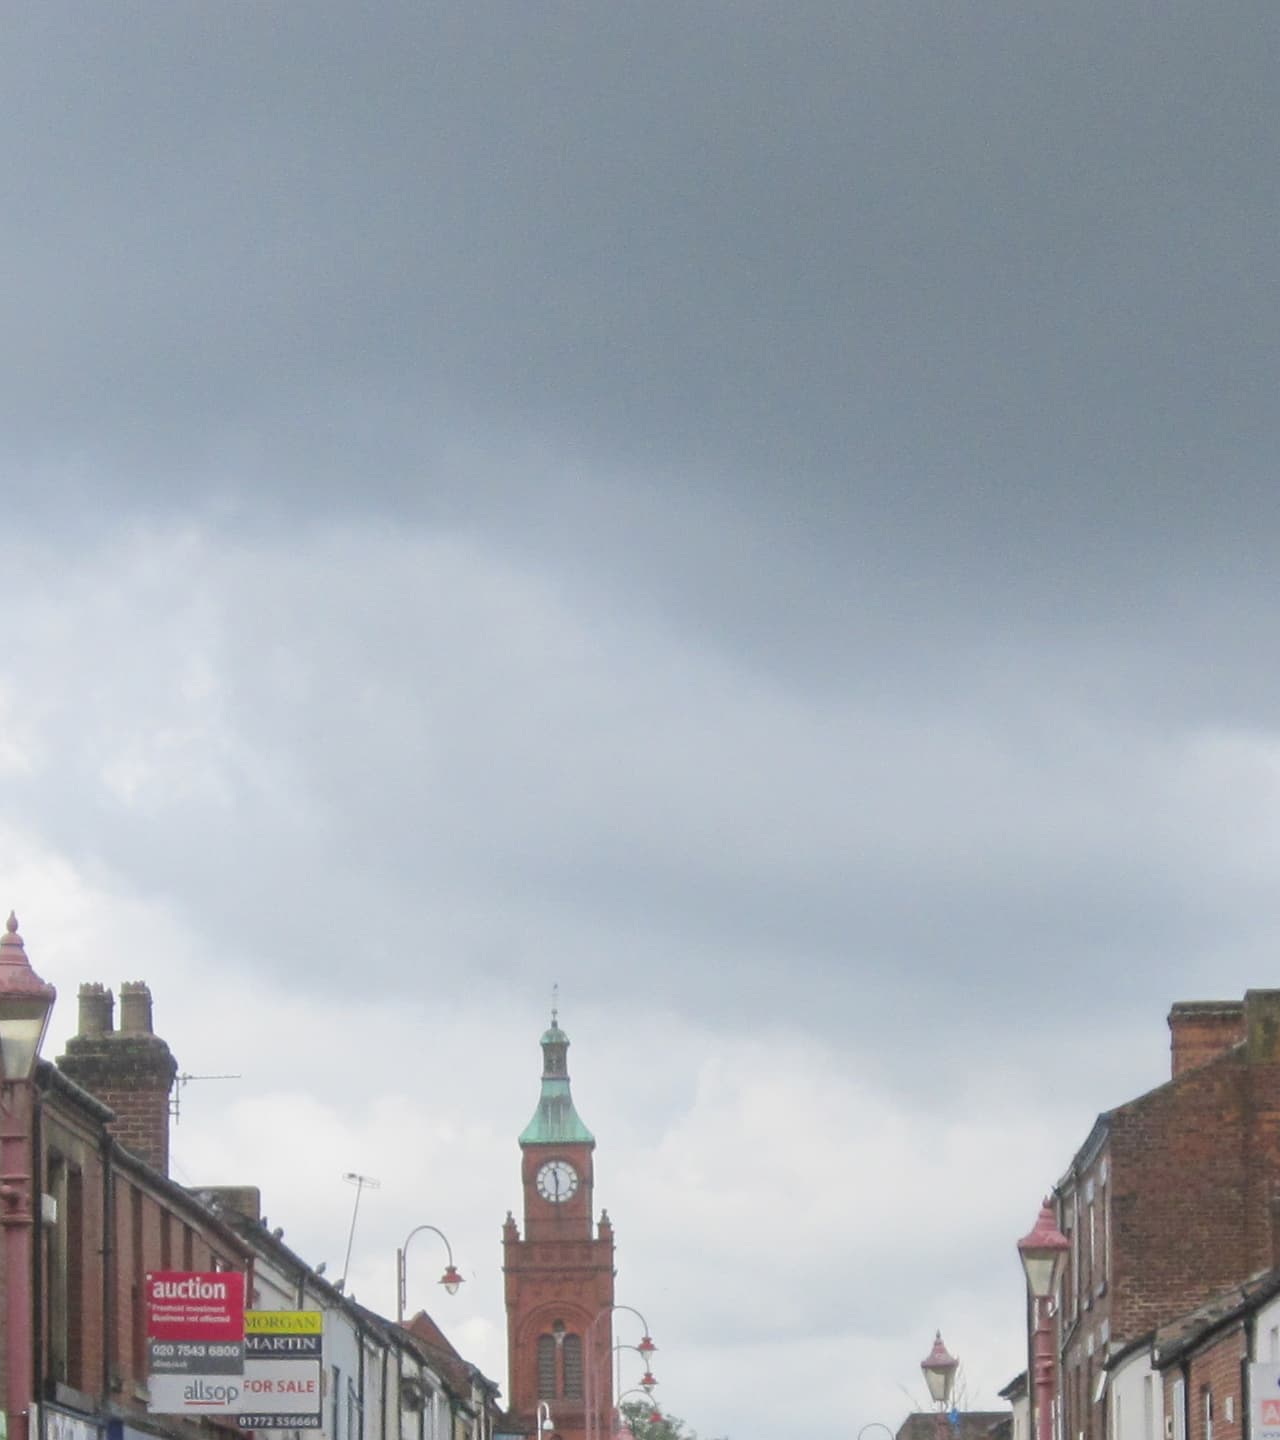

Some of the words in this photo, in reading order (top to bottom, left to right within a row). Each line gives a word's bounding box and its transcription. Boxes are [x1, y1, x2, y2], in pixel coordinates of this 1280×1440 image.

[152, 1277, 226, 1300] auction
[245, 1316, 316, 1329] MORGAN
[152, 1344, 174, 1356] 020
[245, 1337, 316, 1350] MARTIN
[184, 1379, 239, 1405] allsop
[243, 1380, 273, 1393] FOR
[277, 1380, 315, 1393] SALE
